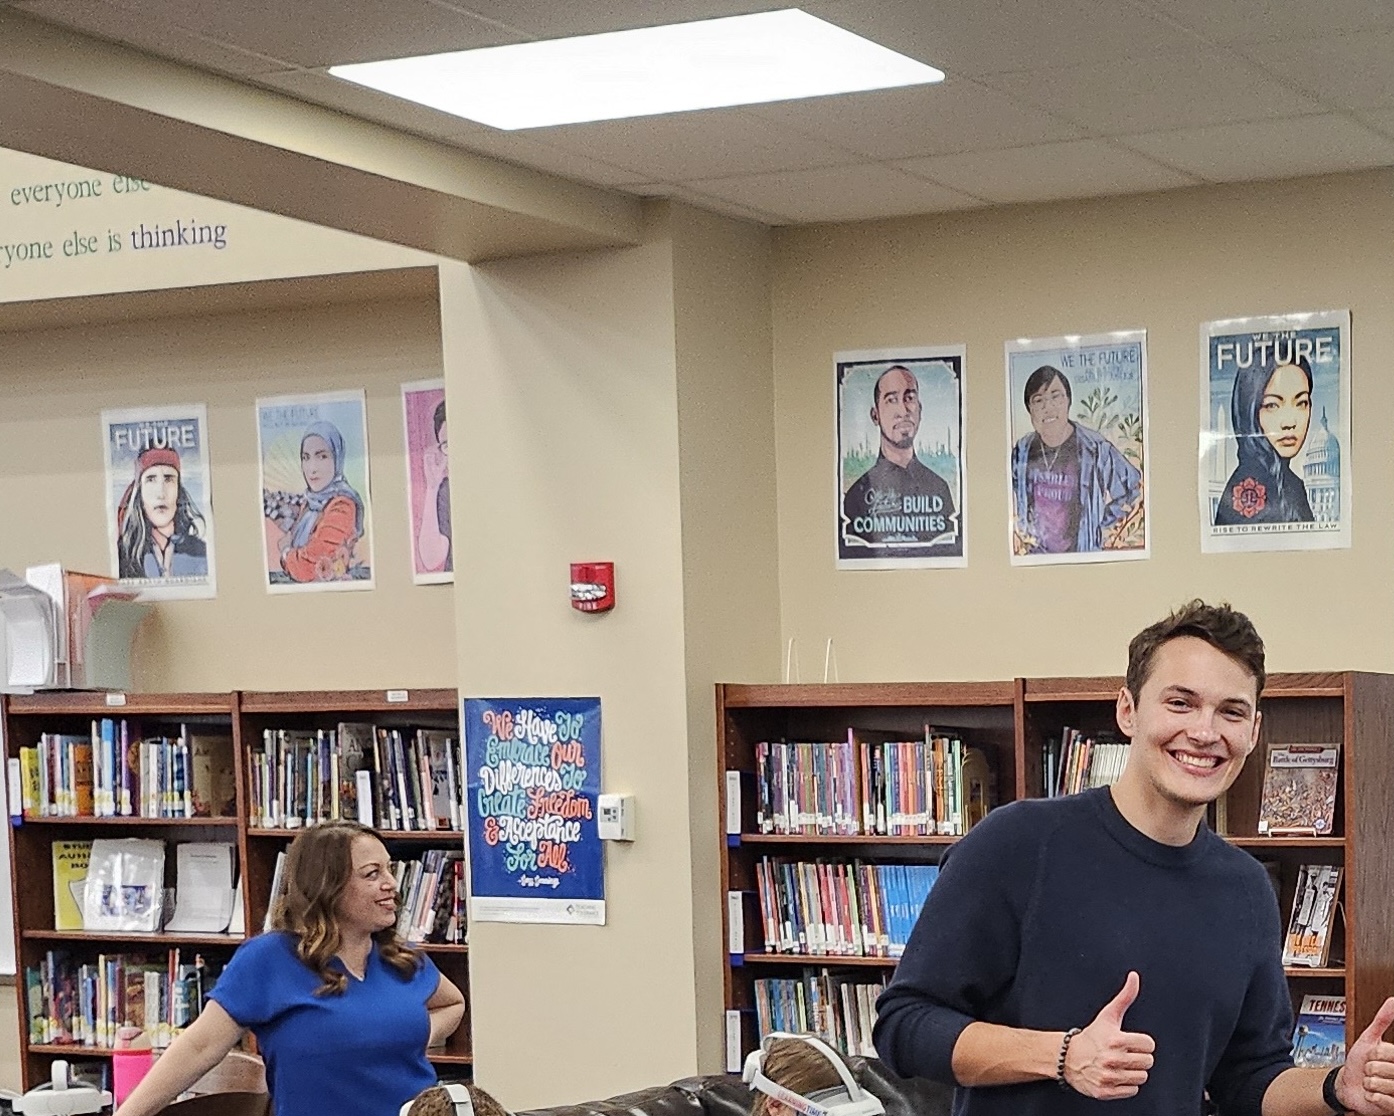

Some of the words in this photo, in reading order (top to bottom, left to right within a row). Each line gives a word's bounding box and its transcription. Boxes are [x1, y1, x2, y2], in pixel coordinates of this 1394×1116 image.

[11, 179, 103, 208] everyone
[63, 231, 98, 257] else
[108, 229, 122, 252] is
[130, 218, 227, 250] thinking
[1252, 332, 1268, 340] WE
[1273, 331, 1296, 339] THE
[1060, 354, 1074, 368] WE
[1079, 353, 1096, 367] THE
[1099, 350, 1136, 366] FUTURE
[1217, 337, 1333, 370] FUTURE
[114, 424, 195, 450] FUTURE
[903, 495, 943, 513] BUILD
[853, 516, 946, 533] COMMUNITIES
[483, 710, 514, 740] We
[514, 709, 558, 744] Have
[555, 711, 584, 741] To
[486, 735, 550, 768] Embrace
[551, 740, 585, 769] Our
[1299, 755, 1334, 765] Gettysburg
[479, 760, 562, 795] Differences
[560, 763, 587, 790] To
[478, 786, 526, 819] Create
[526, 786, 593, 819] Freedom
[484, 816, 499, 845] &
[498, 813, 581, 851] Acceptance
[505, 842, 538, 871] For
[537, 840, 568, 873] All
[1309, 999, 1346, 1013] TENNES
